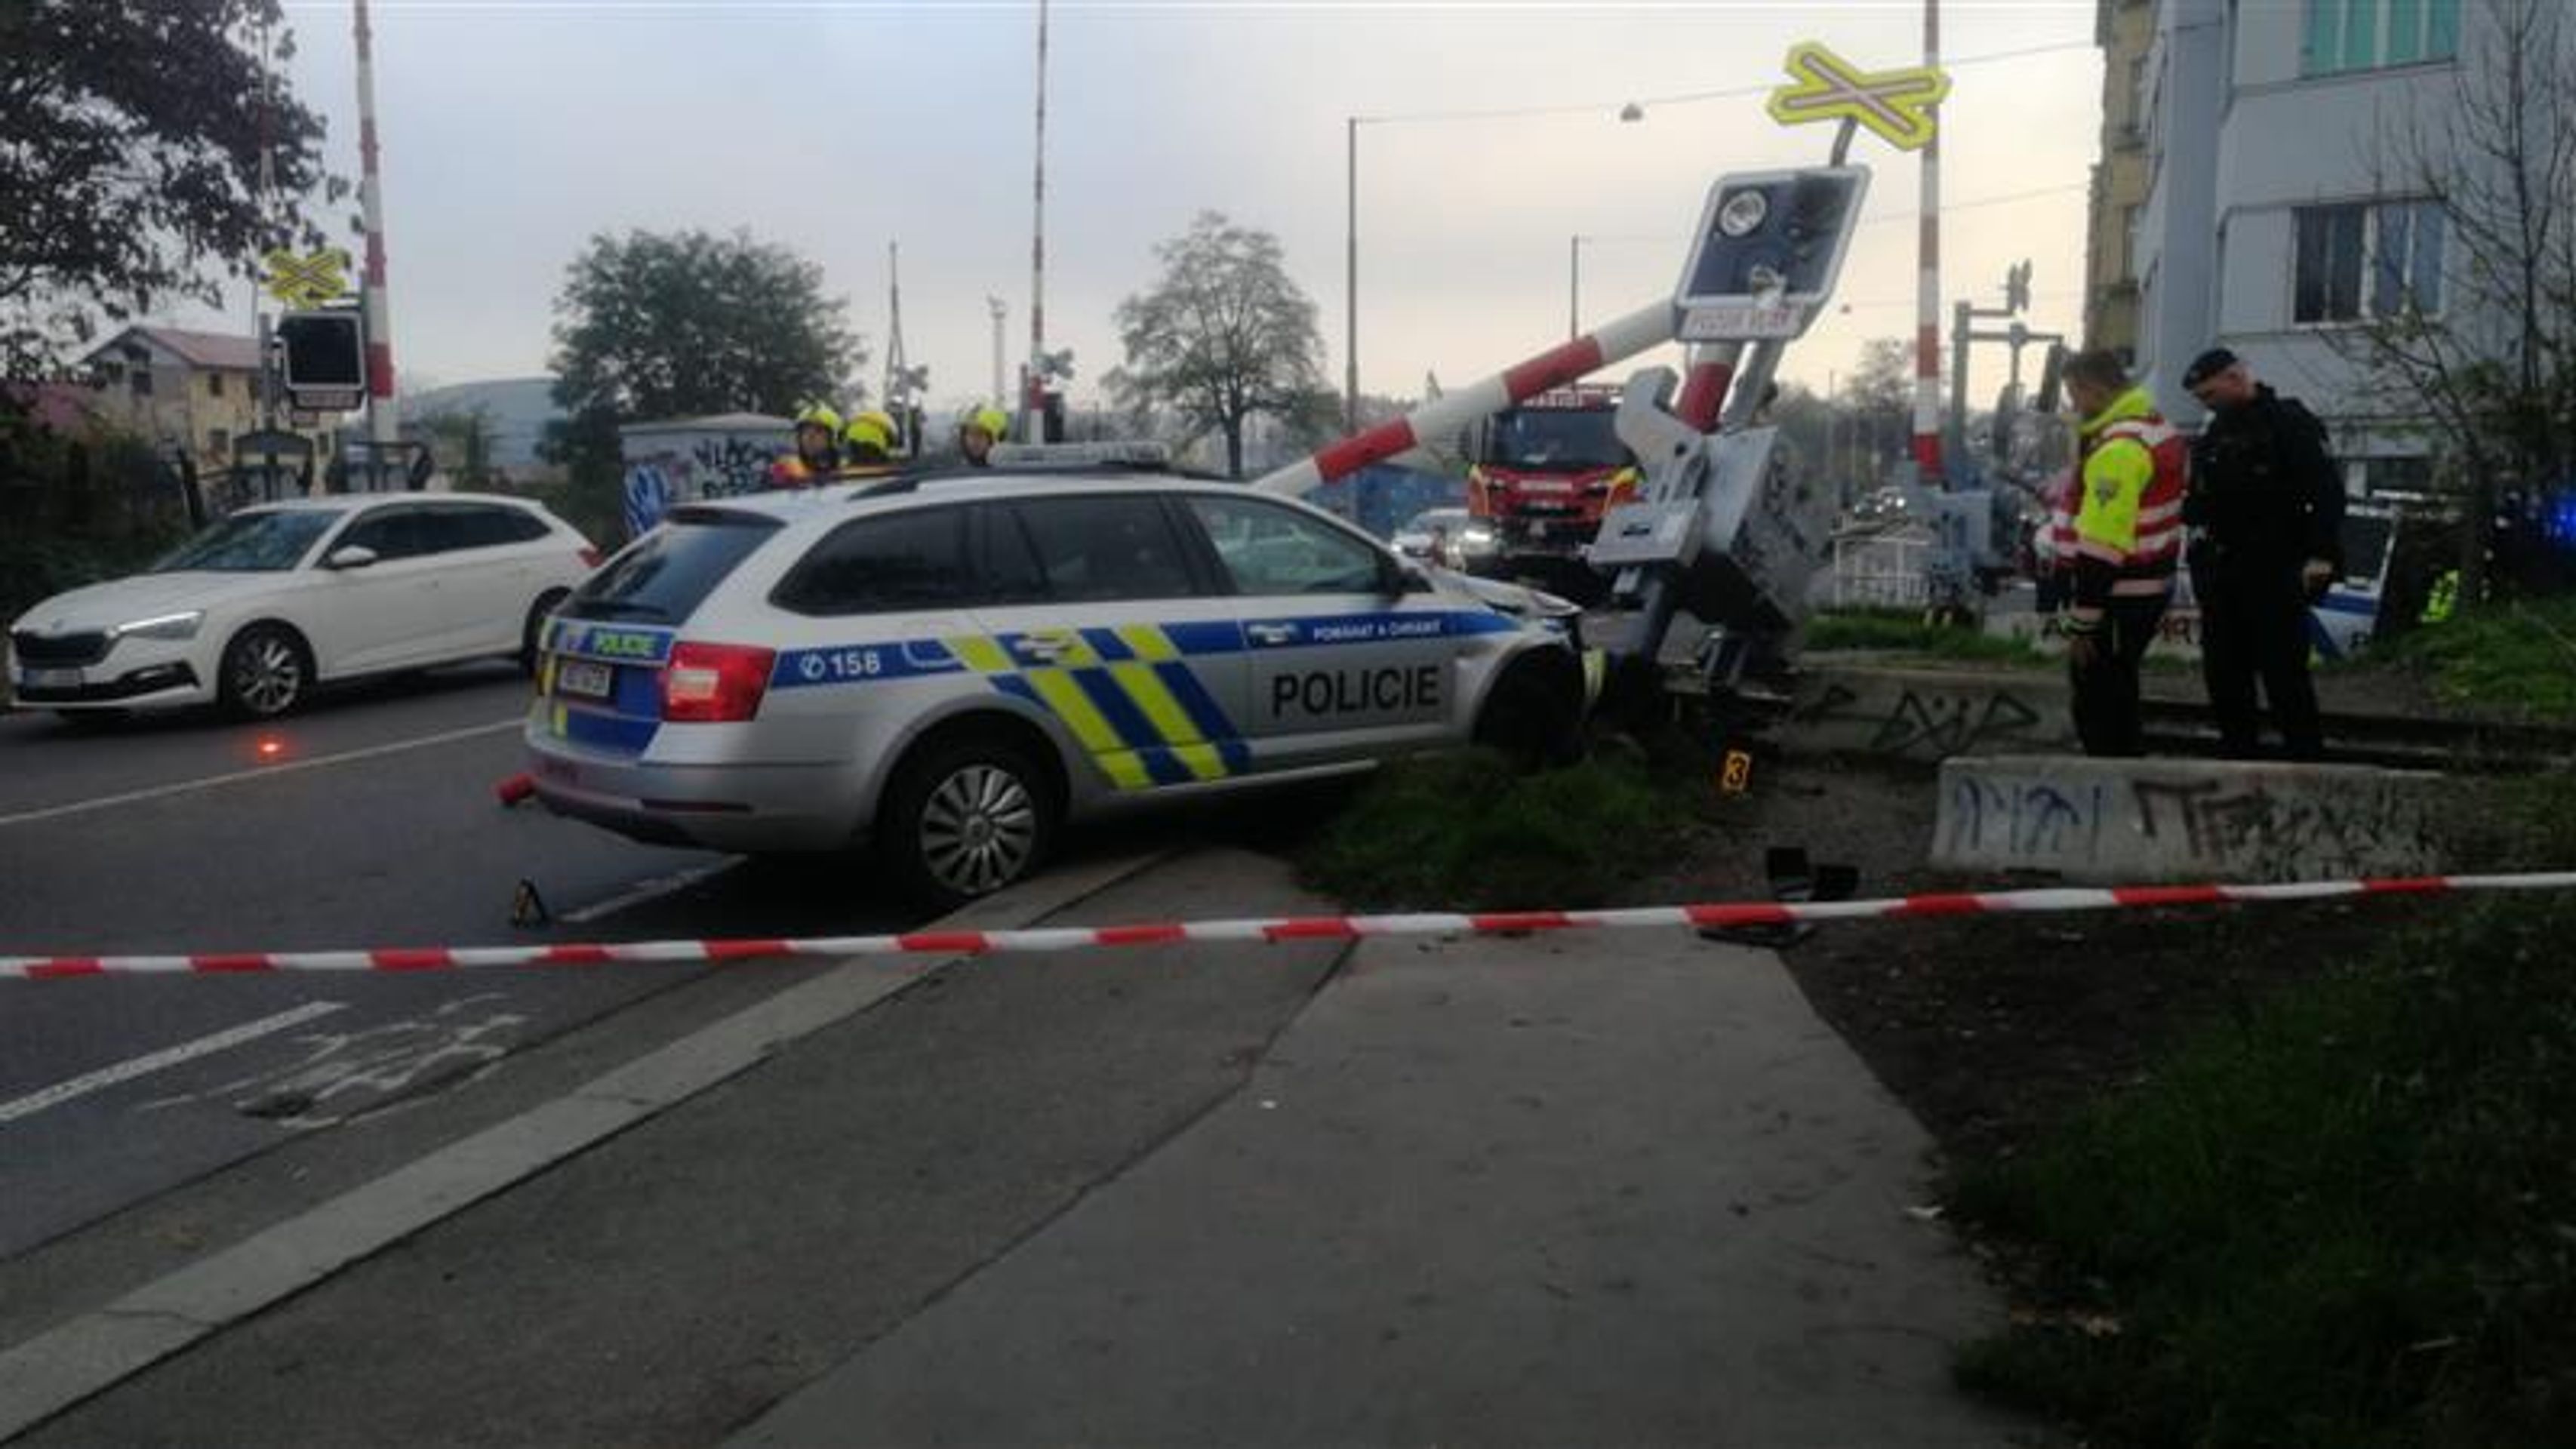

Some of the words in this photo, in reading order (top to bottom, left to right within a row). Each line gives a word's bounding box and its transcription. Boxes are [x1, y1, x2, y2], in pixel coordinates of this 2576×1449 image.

[830, 649, 881, 677] 158
[1273, 665, 1440, 718] POLICIE
[1727, 756, 1747, 786] 3
